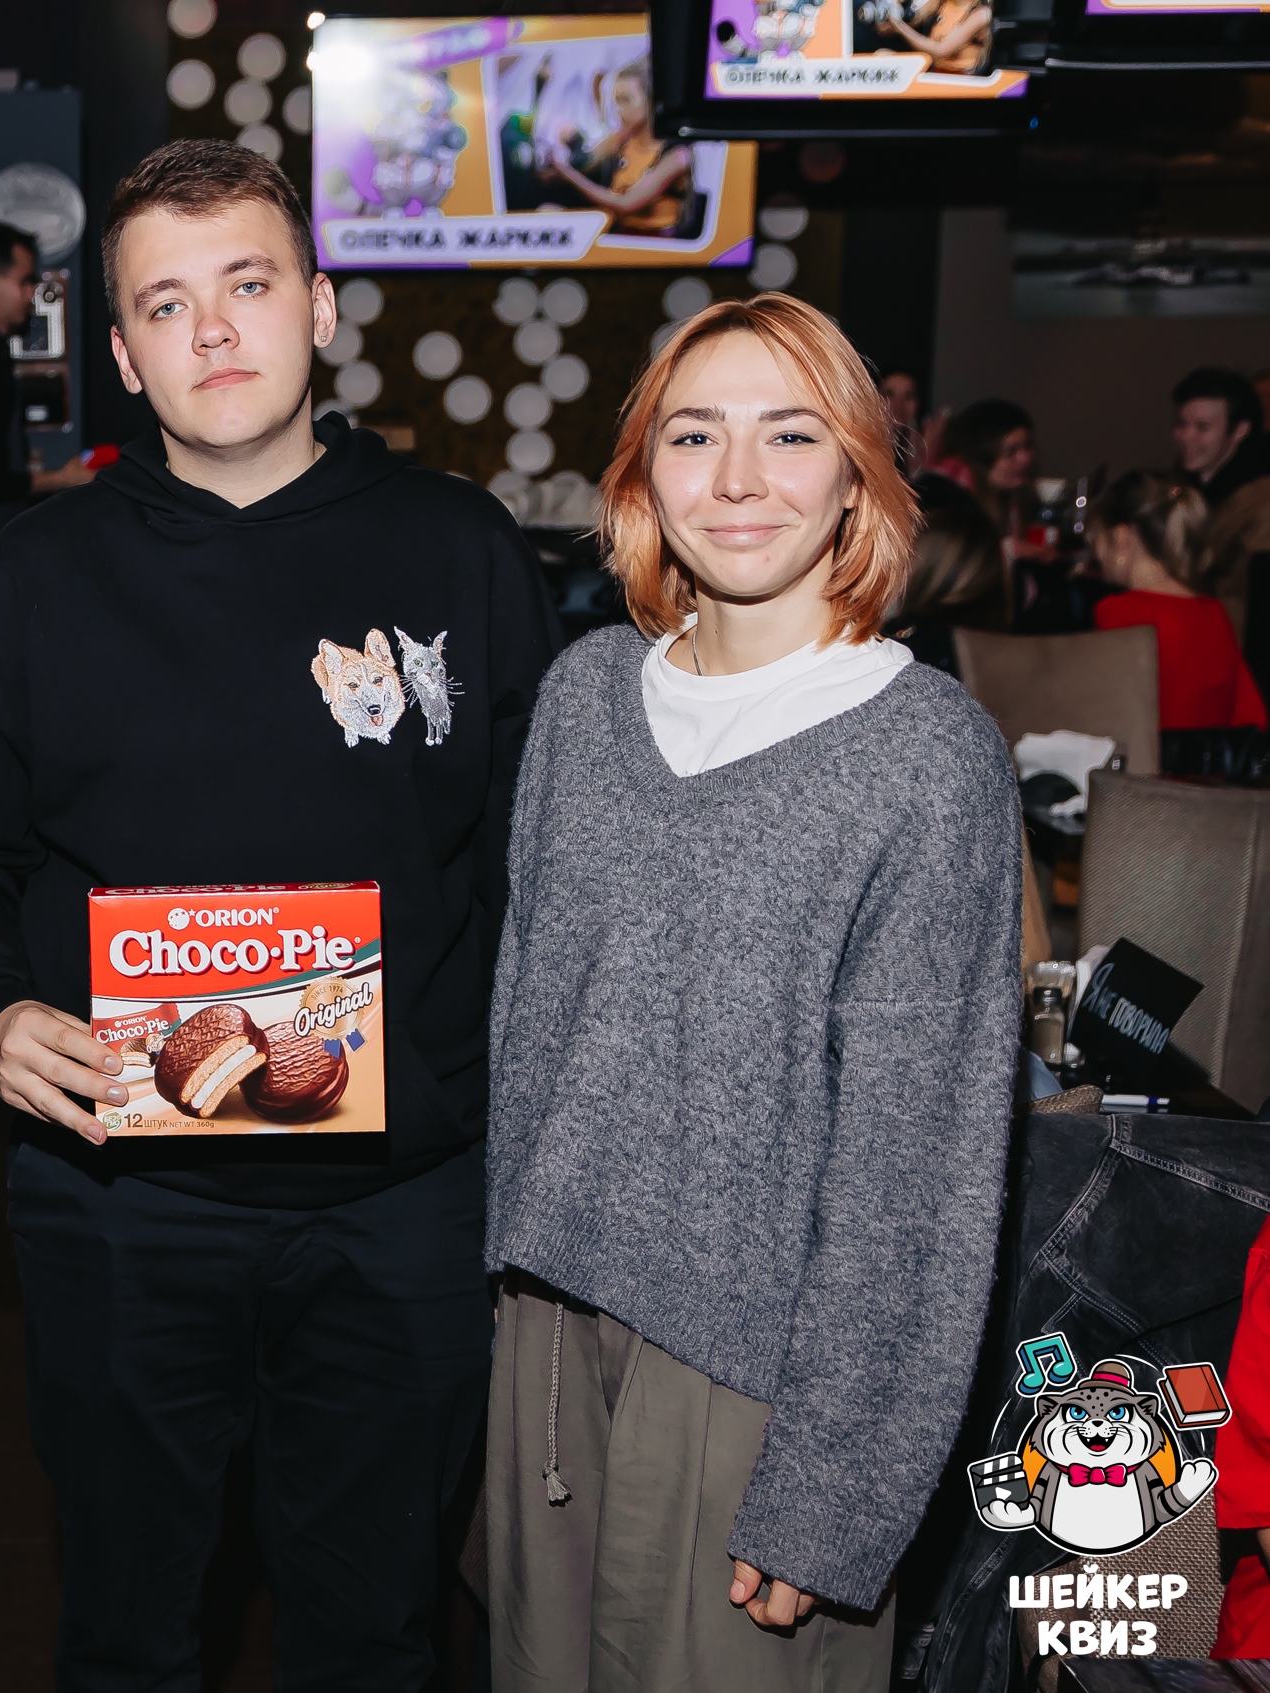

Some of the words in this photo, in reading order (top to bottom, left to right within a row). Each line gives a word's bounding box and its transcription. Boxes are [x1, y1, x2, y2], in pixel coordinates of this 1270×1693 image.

[195, 908, 274, 927] ORION
[311, 986, 328, 1001] SINCE
[329, 985, 344, 994] 1974
[1082, 963, 1114, 1011] Я
[294, 982, 373, 1037] Original
[123, 1016, 146, 1026] ORION
[124, 1113, 143, 1128] 12
[196, 1121, 215, 1129] 360g
